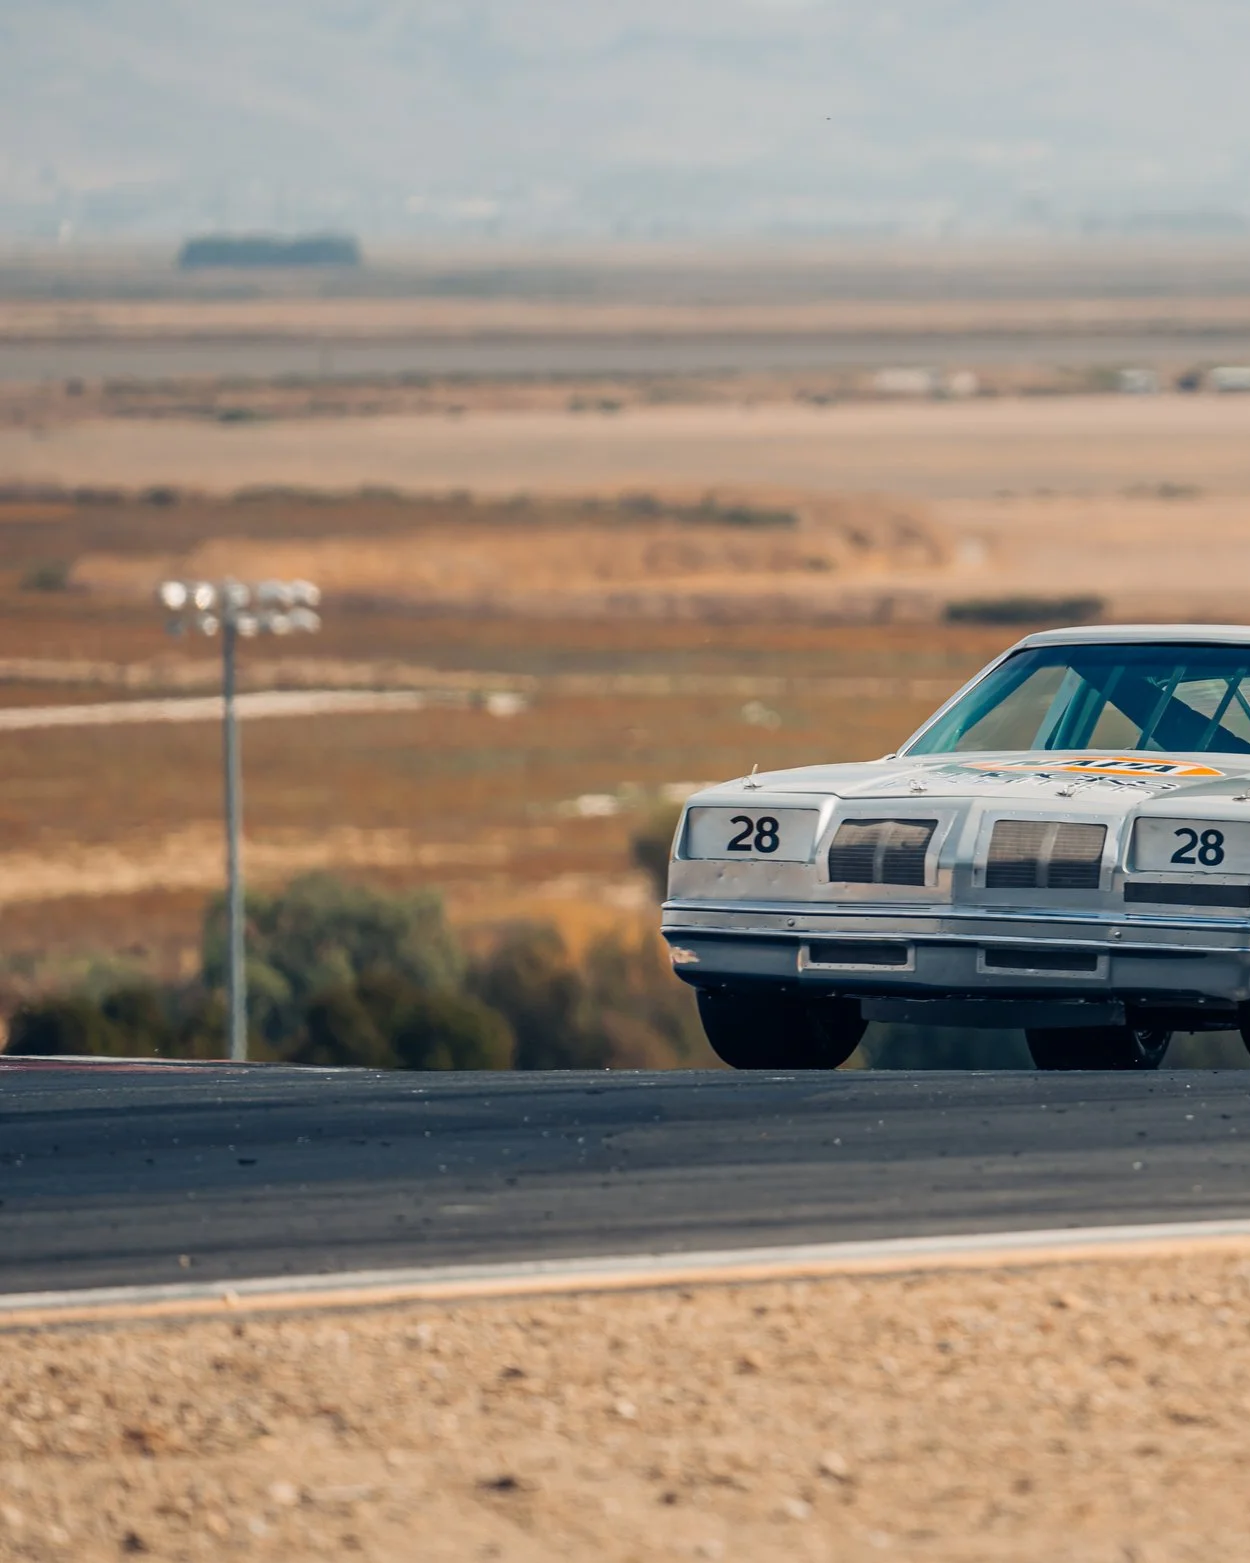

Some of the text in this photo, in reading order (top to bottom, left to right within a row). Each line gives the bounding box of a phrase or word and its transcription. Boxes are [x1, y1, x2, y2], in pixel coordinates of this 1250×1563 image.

[1001, 759, 1179, 773] NAPA
[727, 815, 779, 853] 28
[1170, 827, 1225, 867] 28
